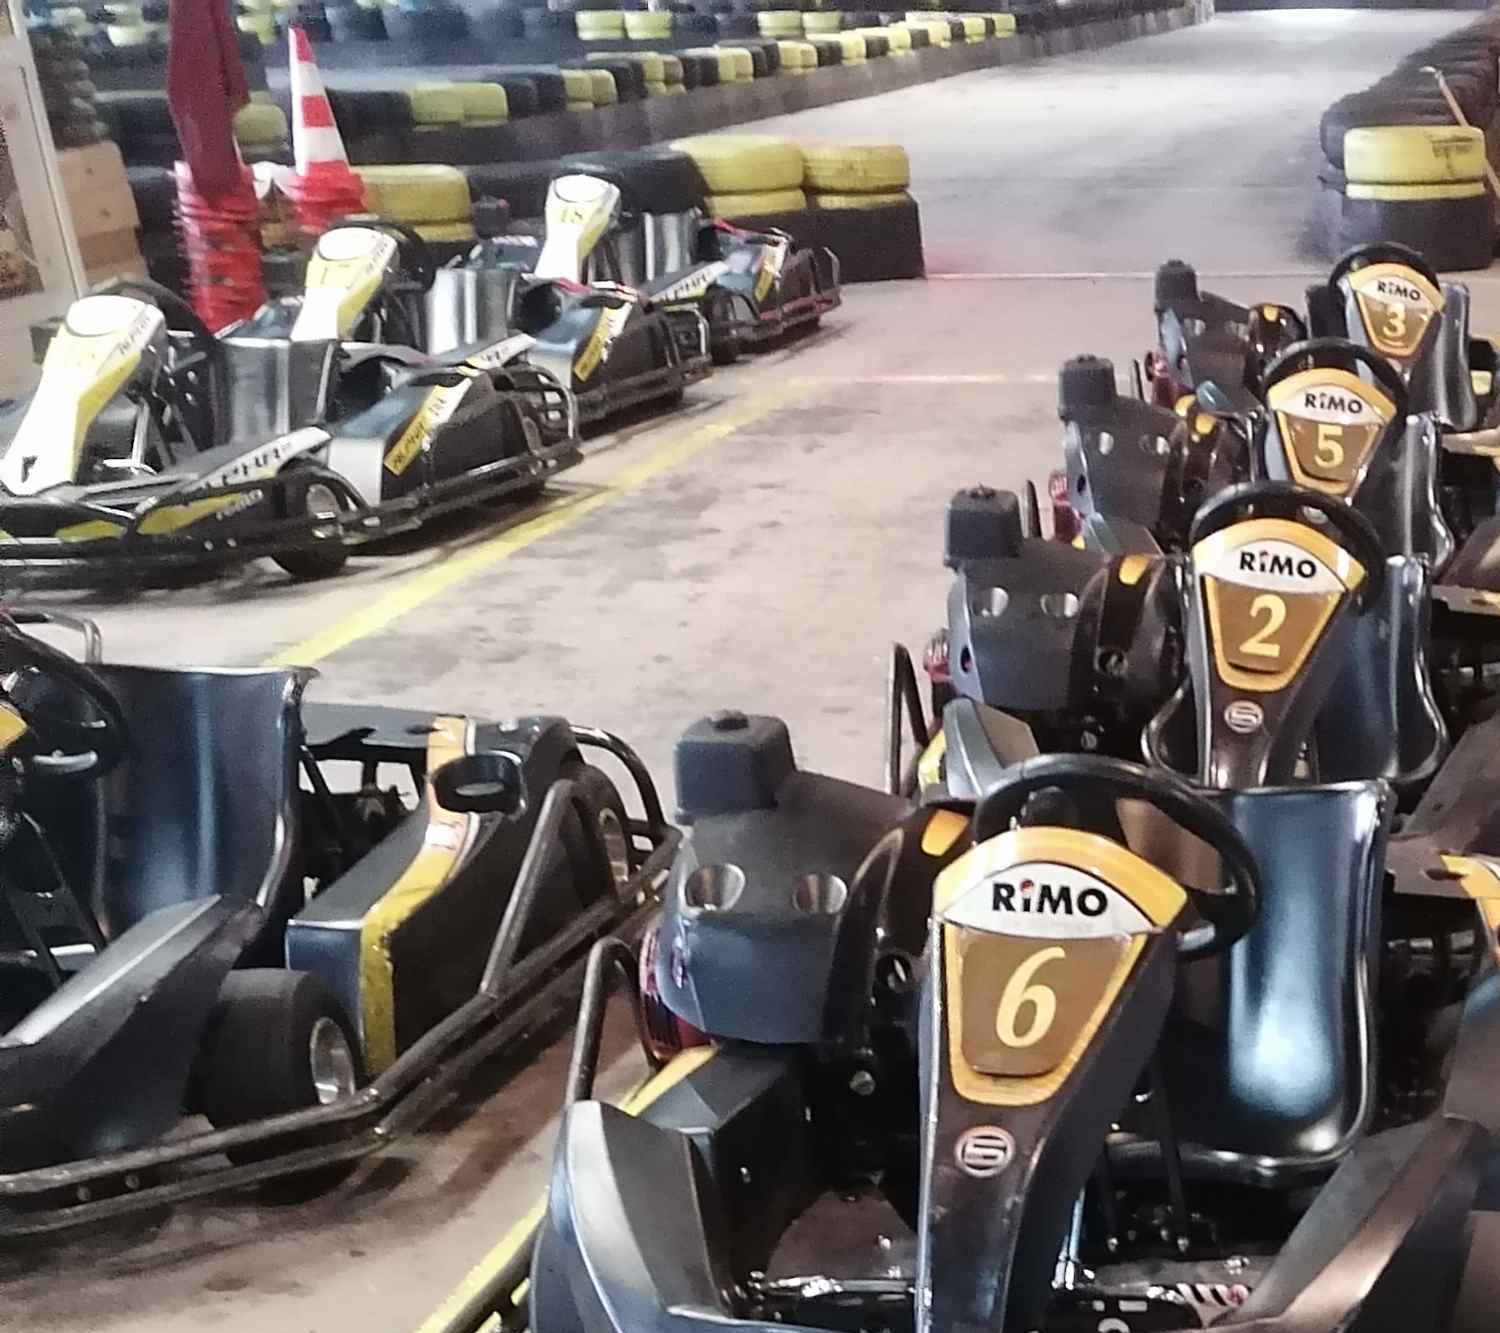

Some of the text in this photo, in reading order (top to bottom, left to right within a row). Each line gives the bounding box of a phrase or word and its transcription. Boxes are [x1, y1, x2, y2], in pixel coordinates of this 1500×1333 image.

[1383, 303, 1406, 337] 3
[1314, 424, 1345, 468] 5
[1239, 593, 1287, 658] 2
[996, 946, 1066, 1048] 6
